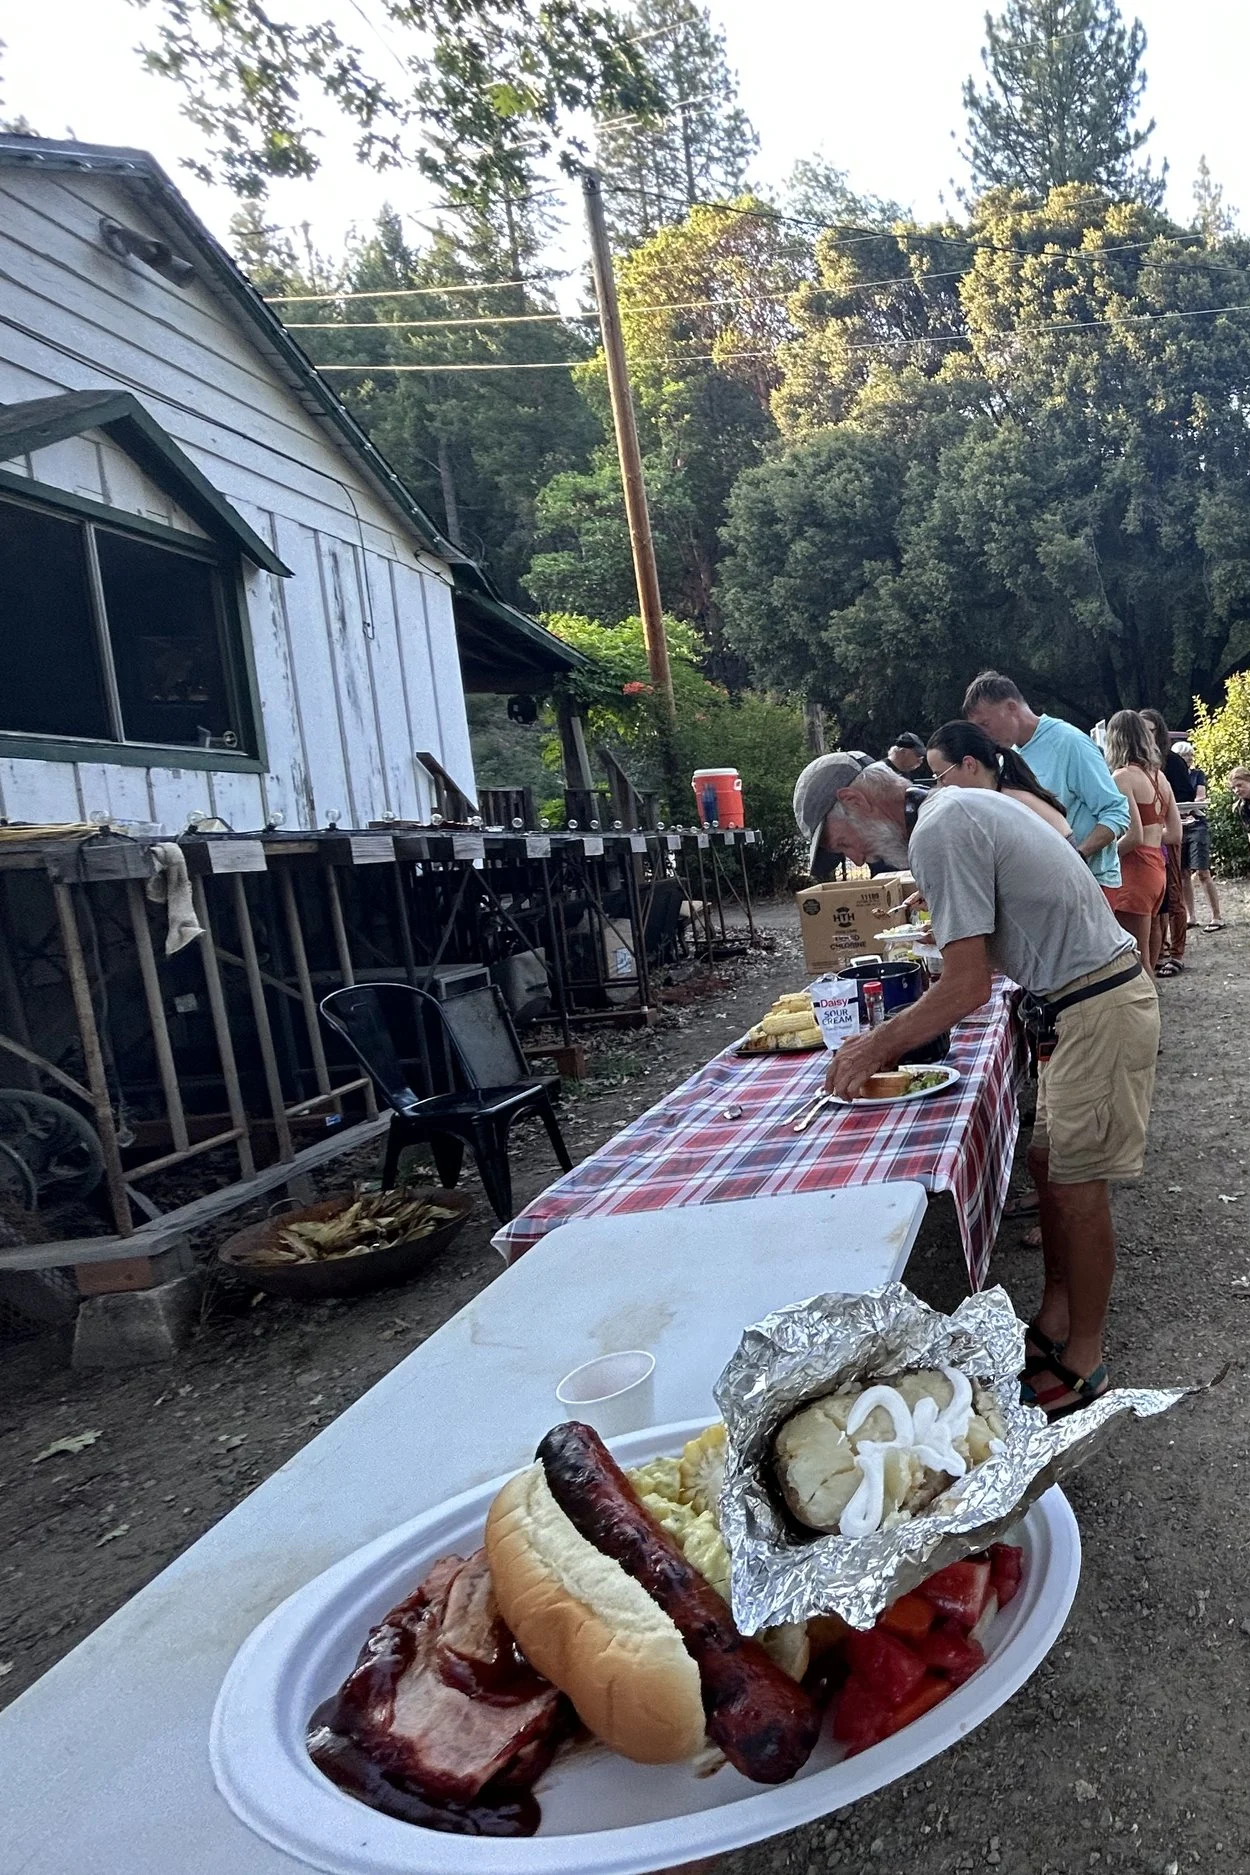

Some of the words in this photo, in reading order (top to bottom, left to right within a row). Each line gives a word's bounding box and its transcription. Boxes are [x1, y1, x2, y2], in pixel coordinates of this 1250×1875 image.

[833, 912, 855, 922] HTH
[820, 999, 848, 1008] Daisy
[824, 1008, 849, 1019] SOUR
[822, 1015, 853, 1026] CREAM
